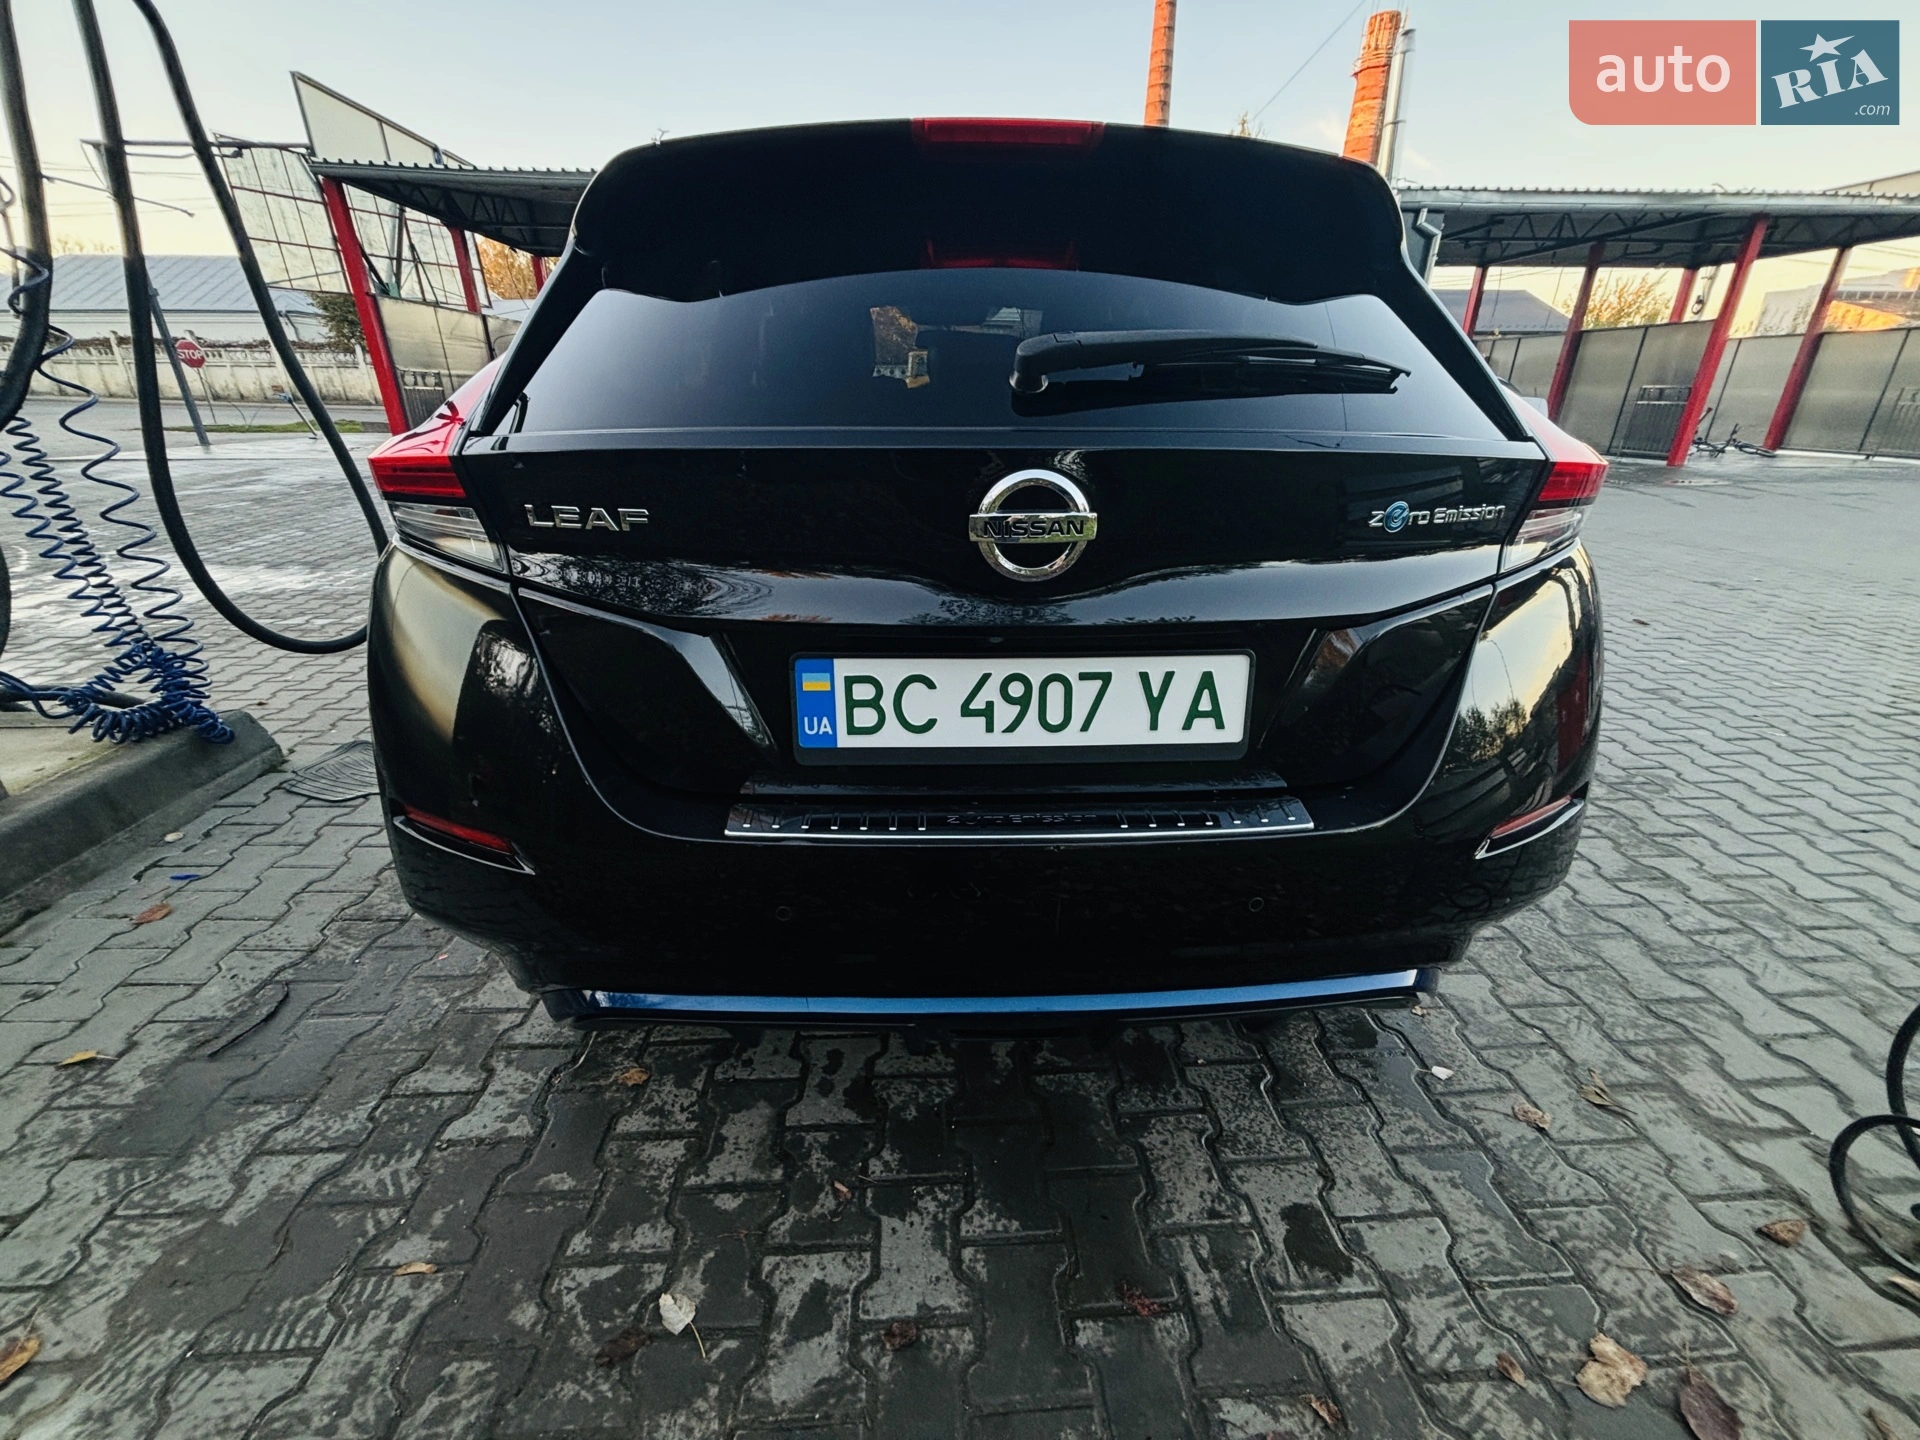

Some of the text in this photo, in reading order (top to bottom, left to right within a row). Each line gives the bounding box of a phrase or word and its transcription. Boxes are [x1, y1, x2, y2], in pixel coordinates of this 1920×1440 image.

[177, 349, 204, 360] STOP
[523, 504, 649, 531] LEAF
[1433, 504, 1506, 524] Emission
[983, 520, 1084, 538] NISSAN
[843, 670, 1226, 736] BC 4907 YA
[803, 716, 833, 735] UA
